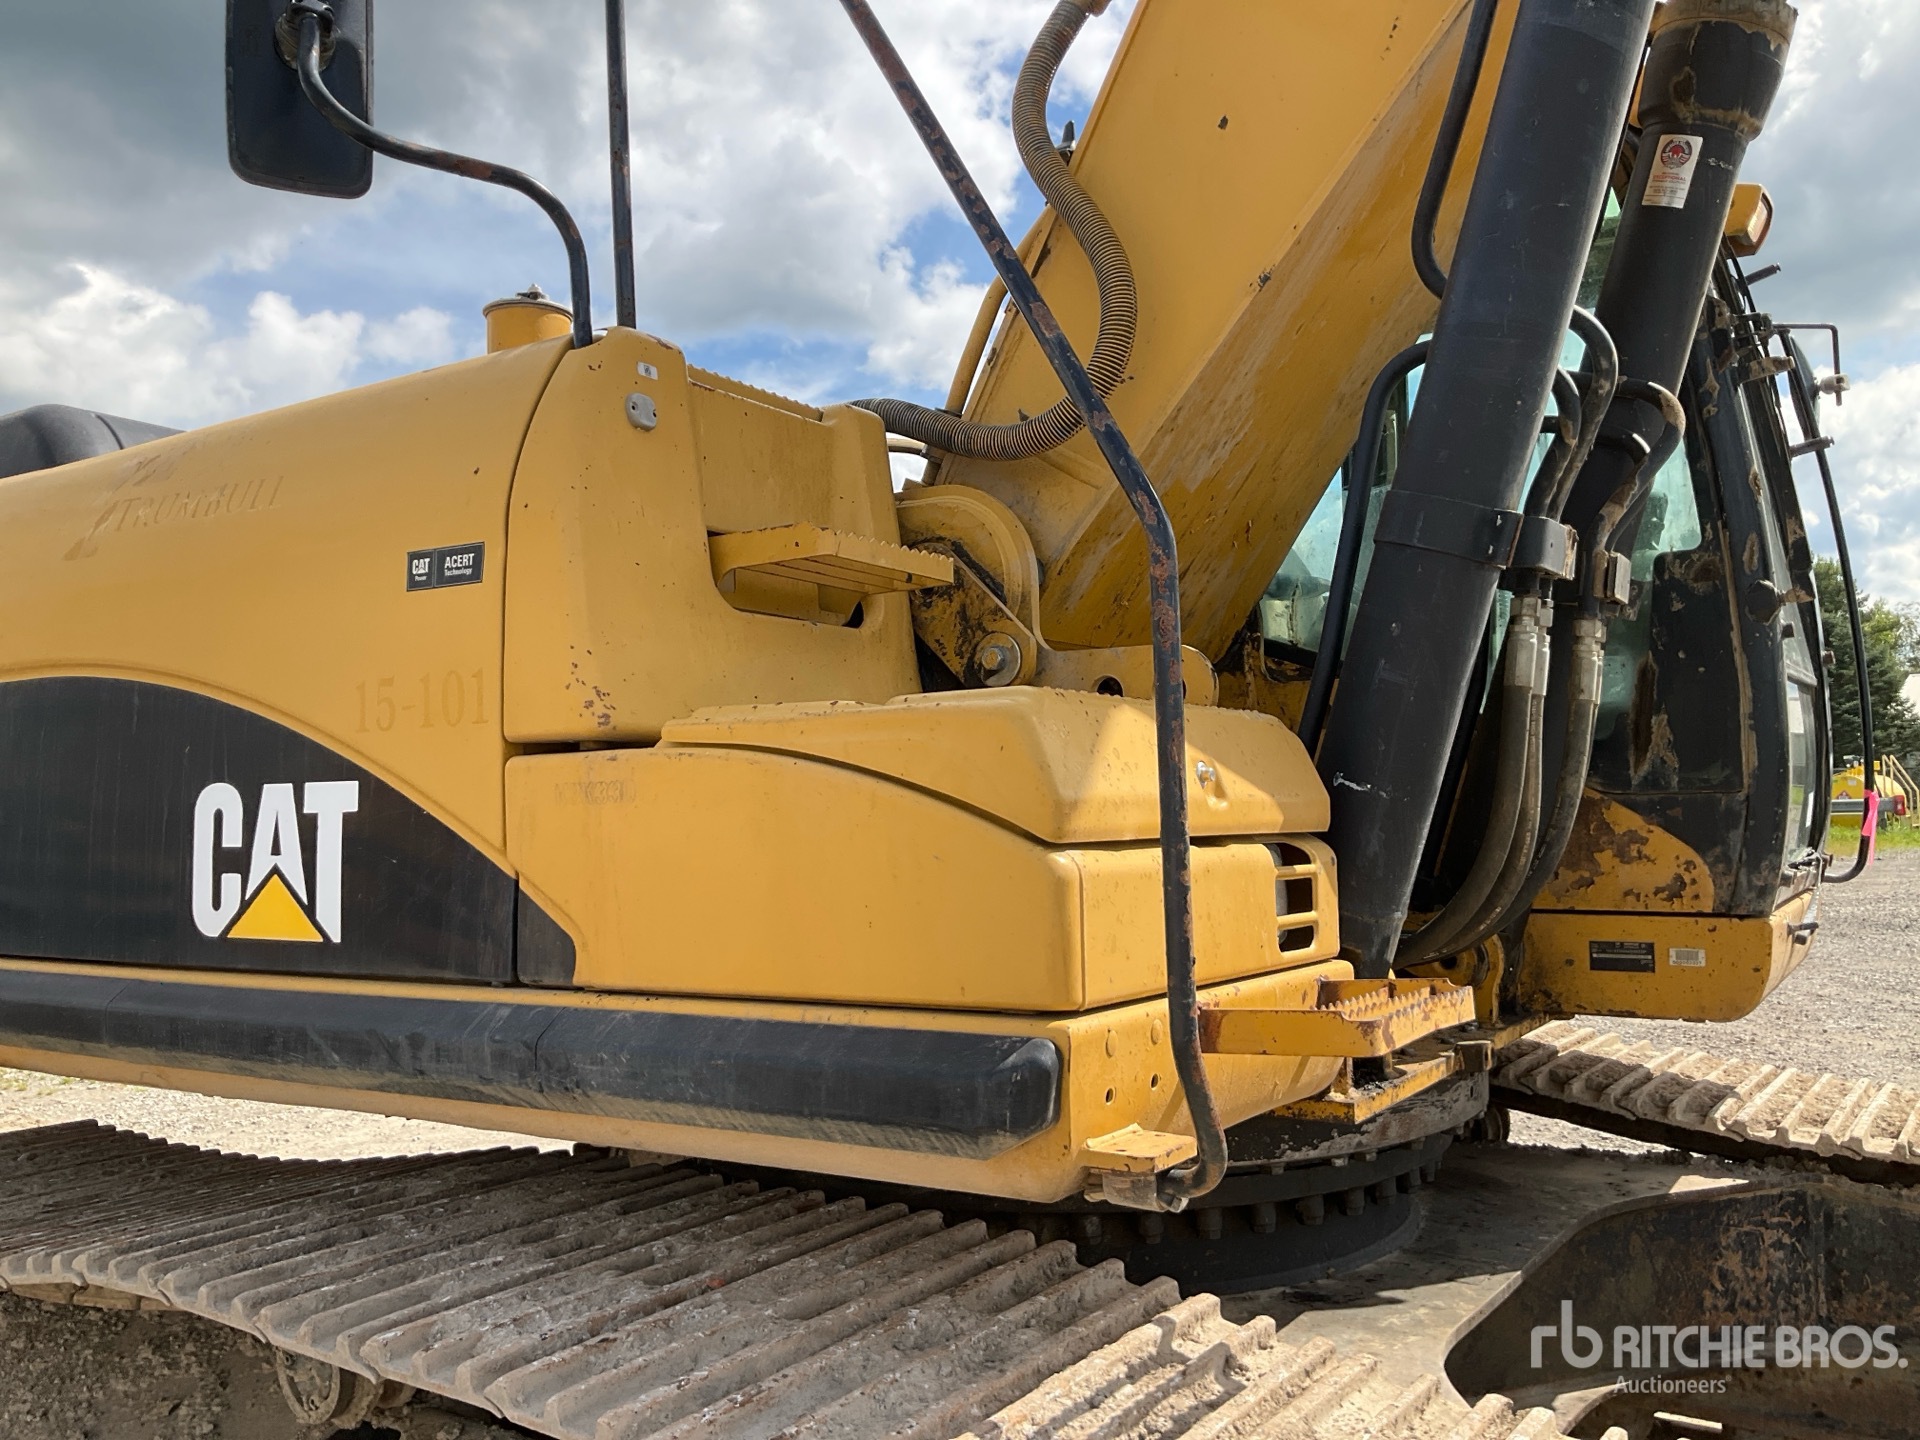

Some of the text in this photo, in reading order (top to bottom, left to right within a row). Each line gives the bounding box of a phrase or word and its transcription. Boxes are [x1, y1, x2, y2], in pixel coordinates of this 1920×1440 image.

[412, 557, 431, 575] CAT
[445, 553, 475, 568] ACERT
[444, 567, 473, 576] Technology
[354, 666, 489, 734] 15-101
[192, 780, 359, 943] CAT
